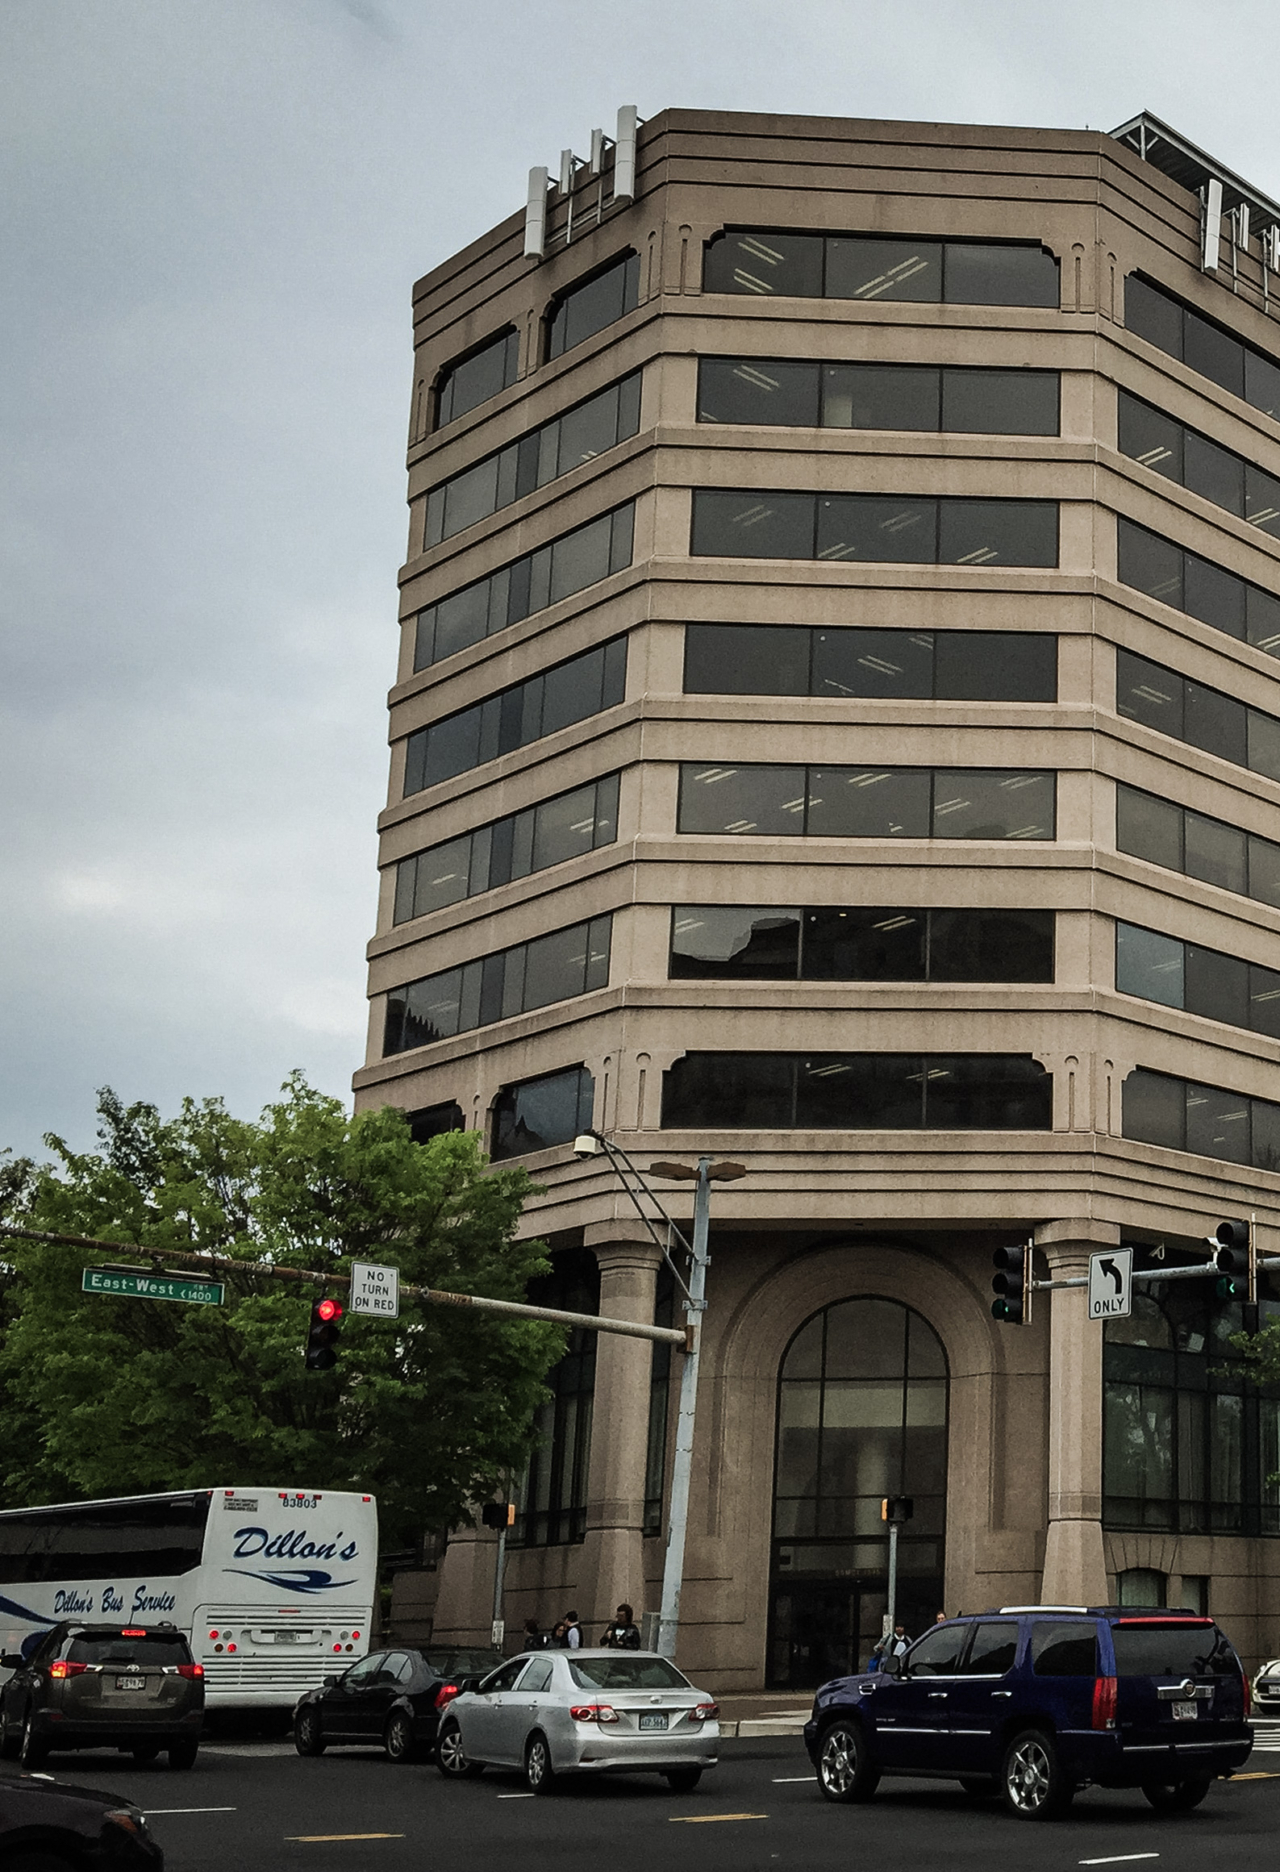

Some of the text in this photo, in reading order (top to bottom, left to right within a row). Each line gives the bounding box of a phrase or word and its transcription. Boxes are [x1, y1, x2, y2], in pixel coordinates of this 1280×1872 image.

[367, 1270, 385, 1282] NO
[91, 1273, 174, 1295] East-West
[361, 1283, 389, 1296] TURN
[188, 1290, 212, 1301] 1400
[354, 1296, 395, 1311] ON RED
[1093, 1297, 1126, 1314] ONLY
[282, 1497, 318, 1509] 83803
[232, 1526, 360, 1561] Dillon's
[54, 1584, 176, 1614] Dillon's Bus Service
